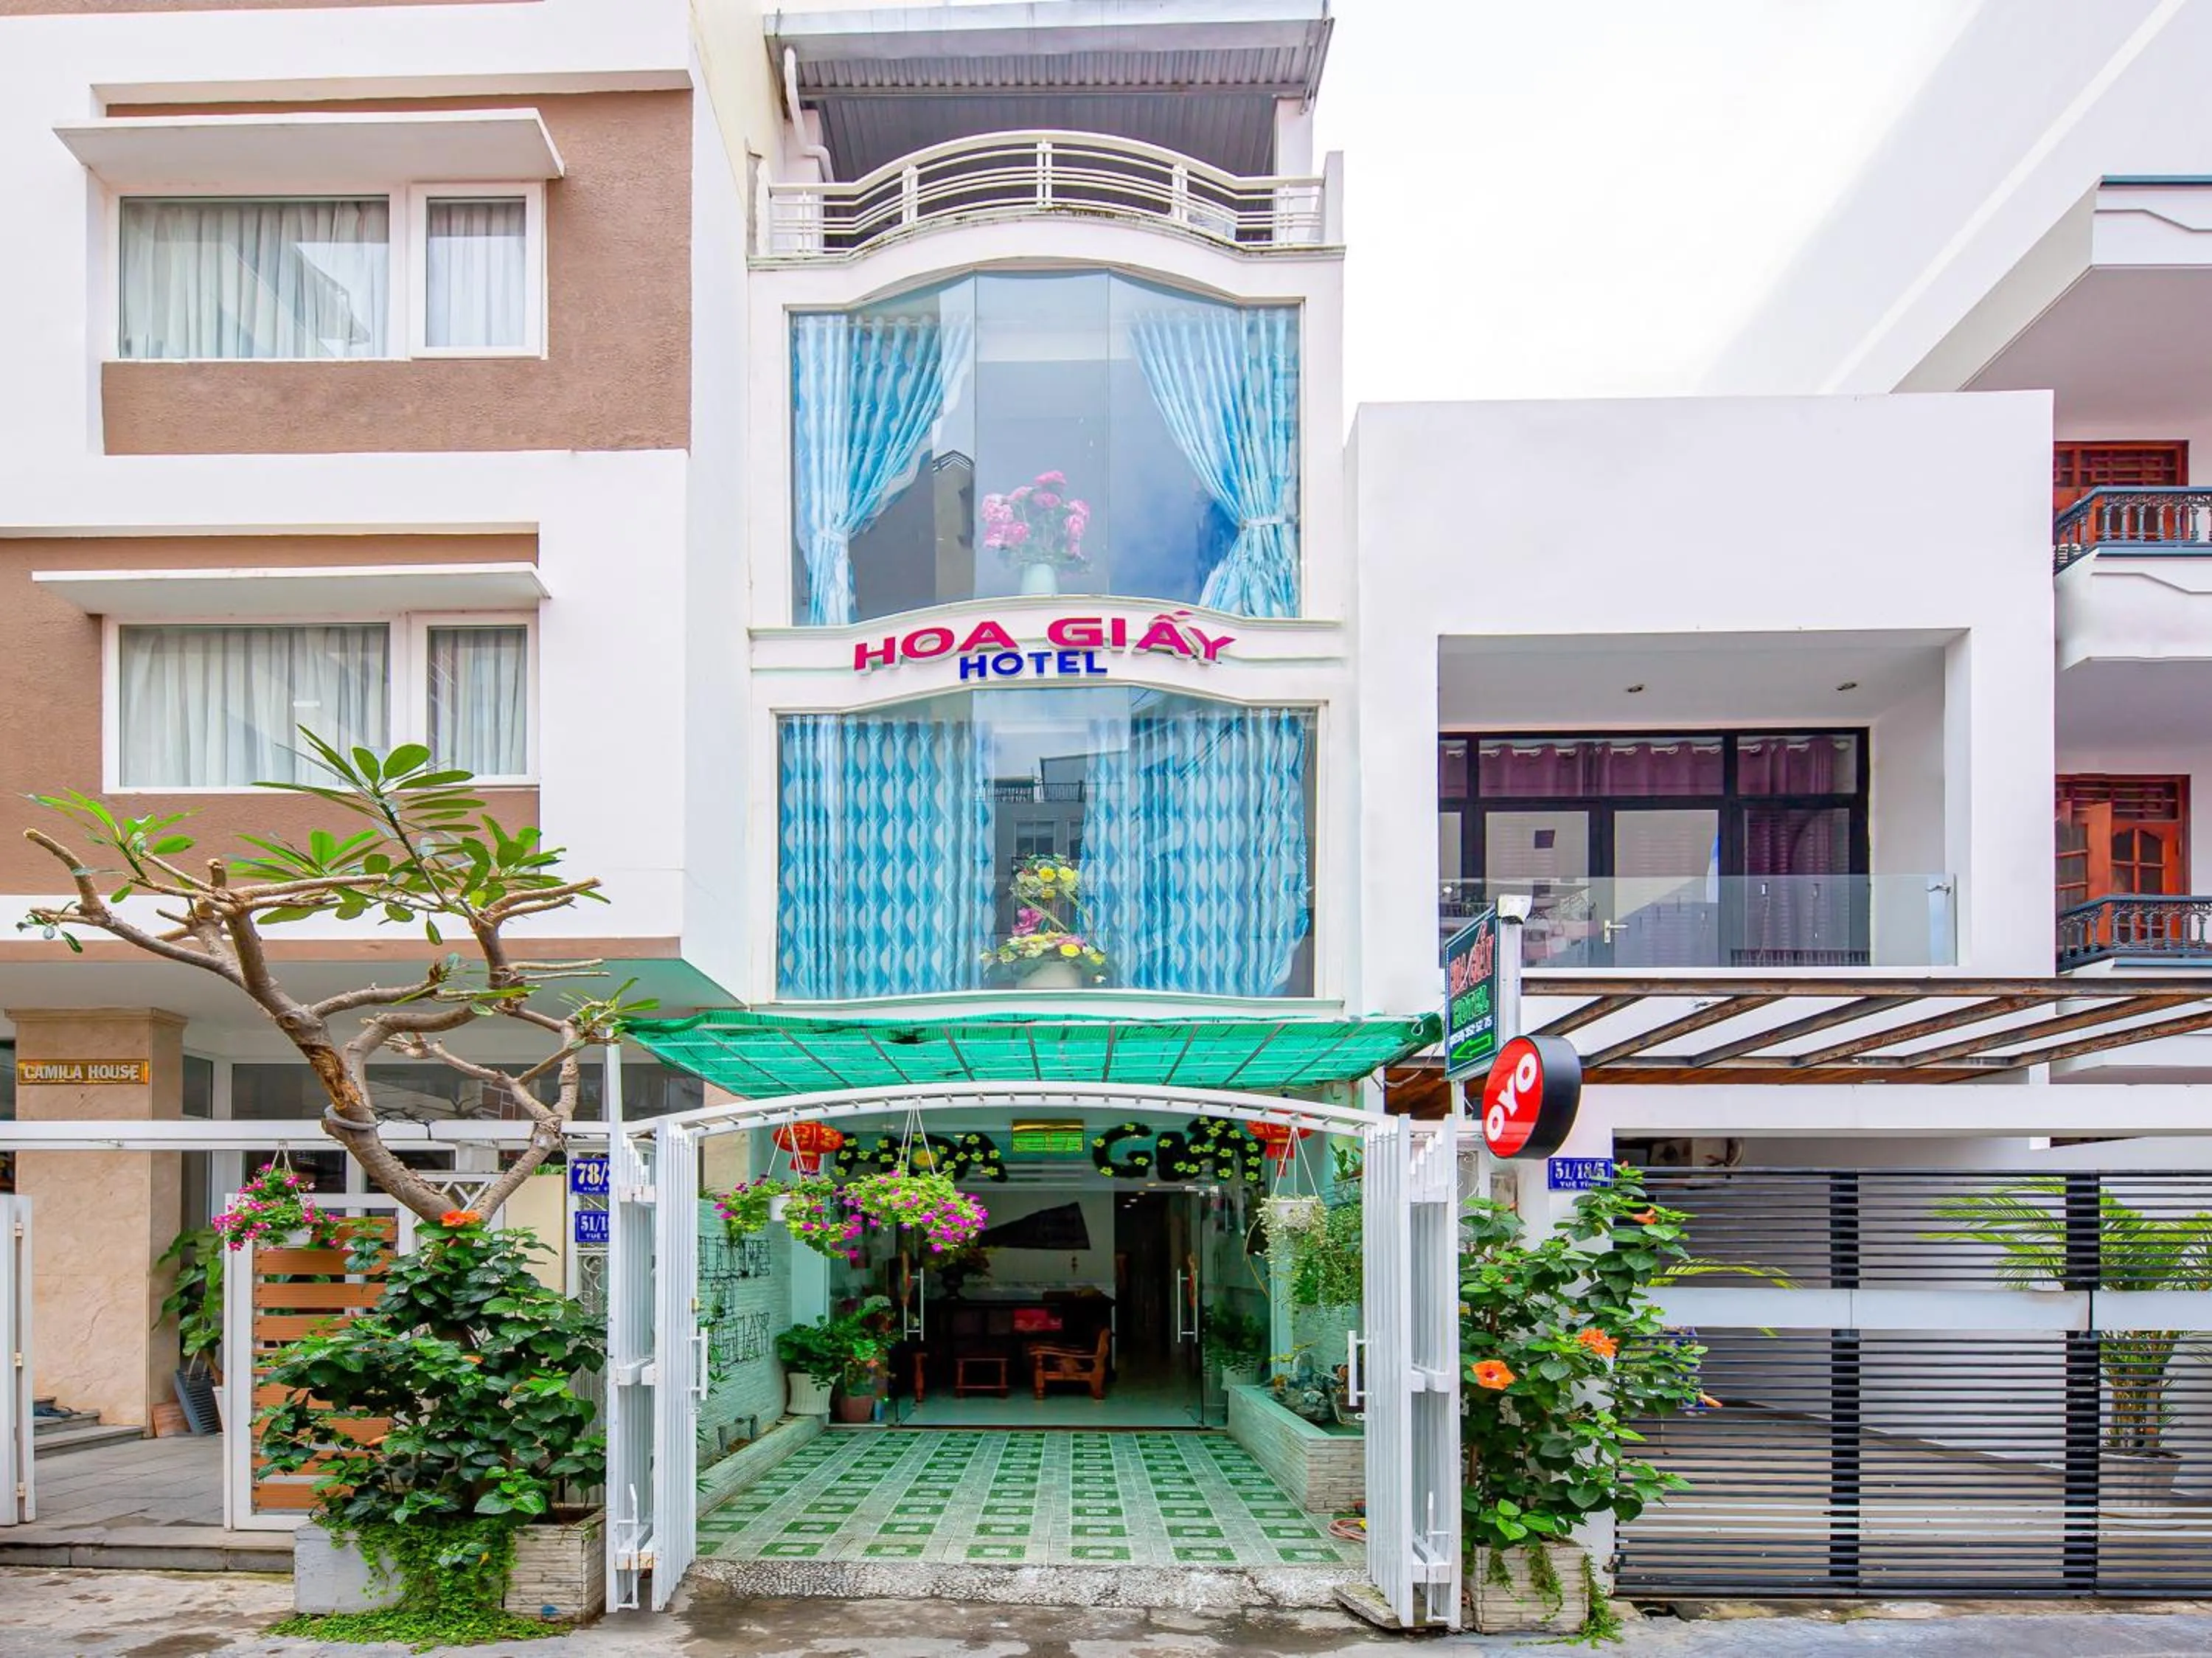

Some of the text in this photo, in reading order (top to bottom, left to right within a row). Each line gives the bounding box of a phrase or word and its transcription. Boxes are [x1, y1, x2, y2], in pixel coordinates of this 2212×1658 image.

[853, 610, 1237, 674] HOA GIẤY
[959, 651, 1108, 681] HOTEL
[24, 1064, 139, 1080] CAMILA HOUSE
[1486, 1052, 1537, 1142] OYO
[576, 1162, 609, 1185] 78/
[580, 1215, 607, 1232] 51/1
